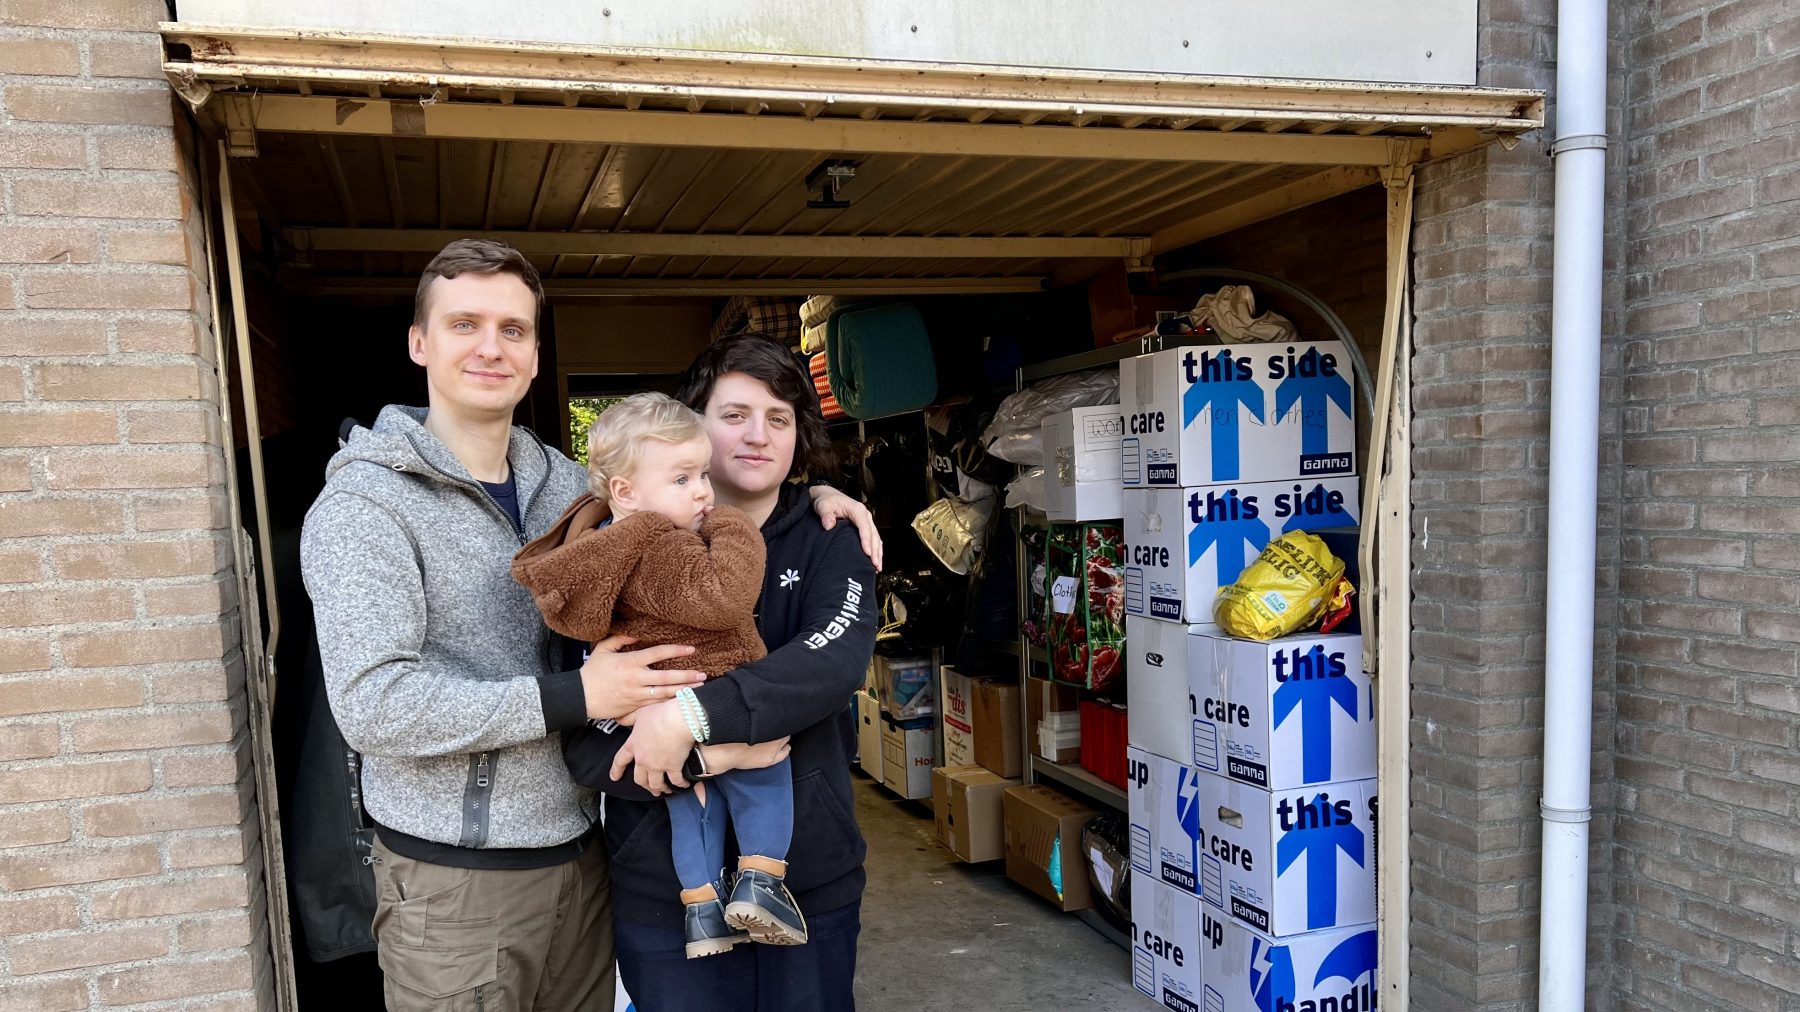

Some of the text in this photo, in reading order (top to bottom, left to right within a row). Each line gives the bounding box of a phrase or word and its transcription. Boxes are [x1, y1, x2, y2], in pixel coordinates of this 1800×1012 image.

[1183, 346, 1338, 383] this side
[1131, 411, 1164, 435] care
[1188, 484, 1344, 523] this side
[1134, 545, 1169, 568] care
[1273, 645, 1347, 682] this
[1204, 698, 1250, 727] care
[1128, 758, 1149, 789] up
[1277, 793, 1352, 831] this
[1211, 835, 1253, 871] care
[1144, 931, 1184, 967] care
[1203, 913, 1224, 949] up
